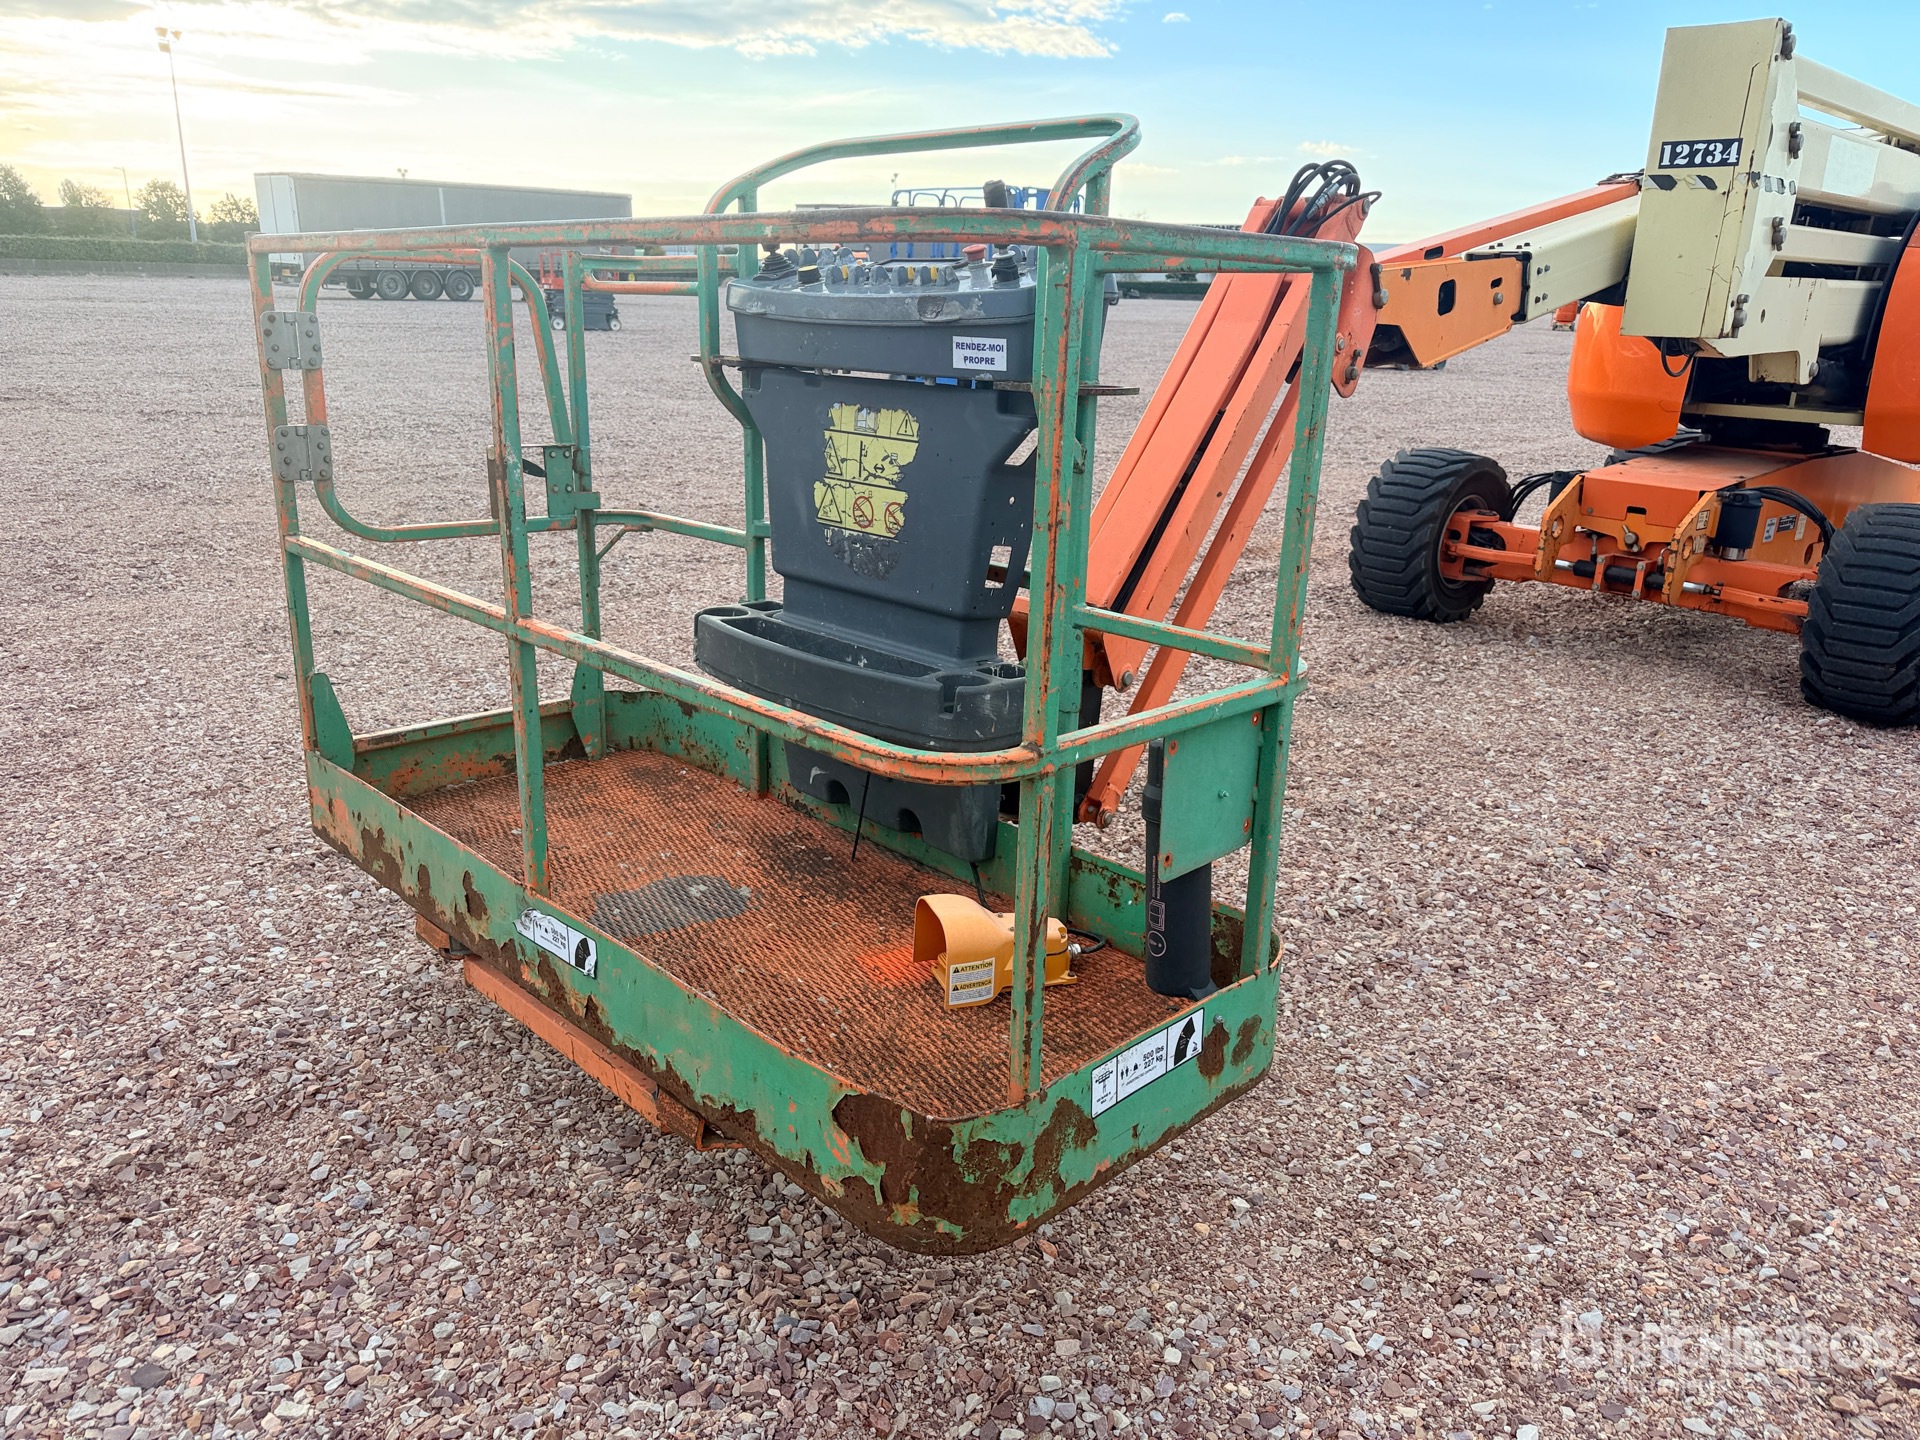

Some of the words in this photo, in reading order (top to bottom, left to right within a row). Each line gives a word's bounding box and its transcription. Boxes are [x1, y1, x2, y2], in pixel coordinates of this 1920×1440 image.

[1660, 142, 1739, 166] 12734
[955, 341, 1004, 352] RENDEZ-MOI
[963, 355, 996, 366] PROPRE
[960, 961, 993, 972] ATTENTION
[1142, 1049, 1154, 1062] 500
[1154, 1044, 1165, 1055] lbs
[1143, 1057, 1154, 1070] 227
[1155, 1053, 1164, 1064] kg
